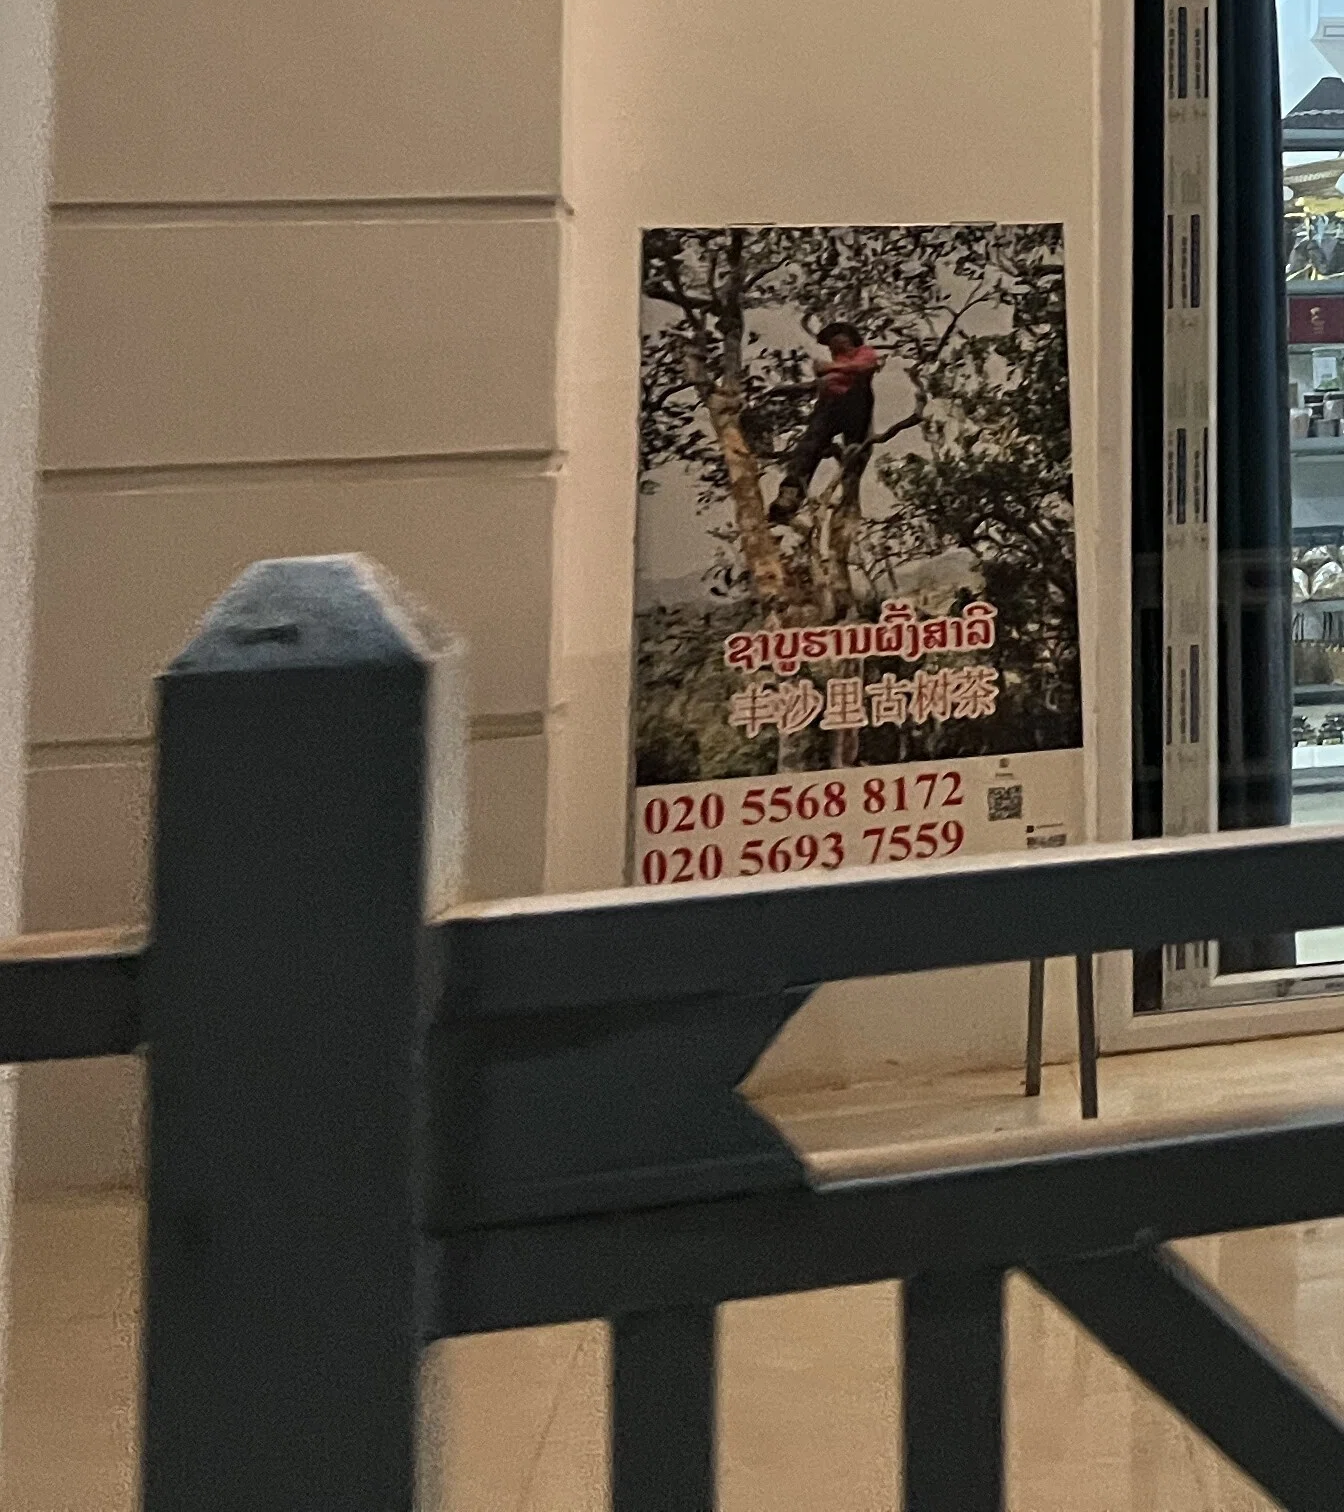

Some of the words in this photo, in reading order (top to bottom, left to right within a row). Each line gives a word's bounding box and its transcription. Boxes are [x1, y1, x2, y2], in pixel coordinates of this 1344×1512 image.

[730, 666, 998, 736] 丰沙里古树茶
[643, 792, 726, 835] 020
[741, 781, 847, 826] 5568
[862, 771, 965, 814] 8172
[642, 843, 724, 886] 020
[739, 831, 845, 877] 5693
[862, 819, 965, 864] 7559
